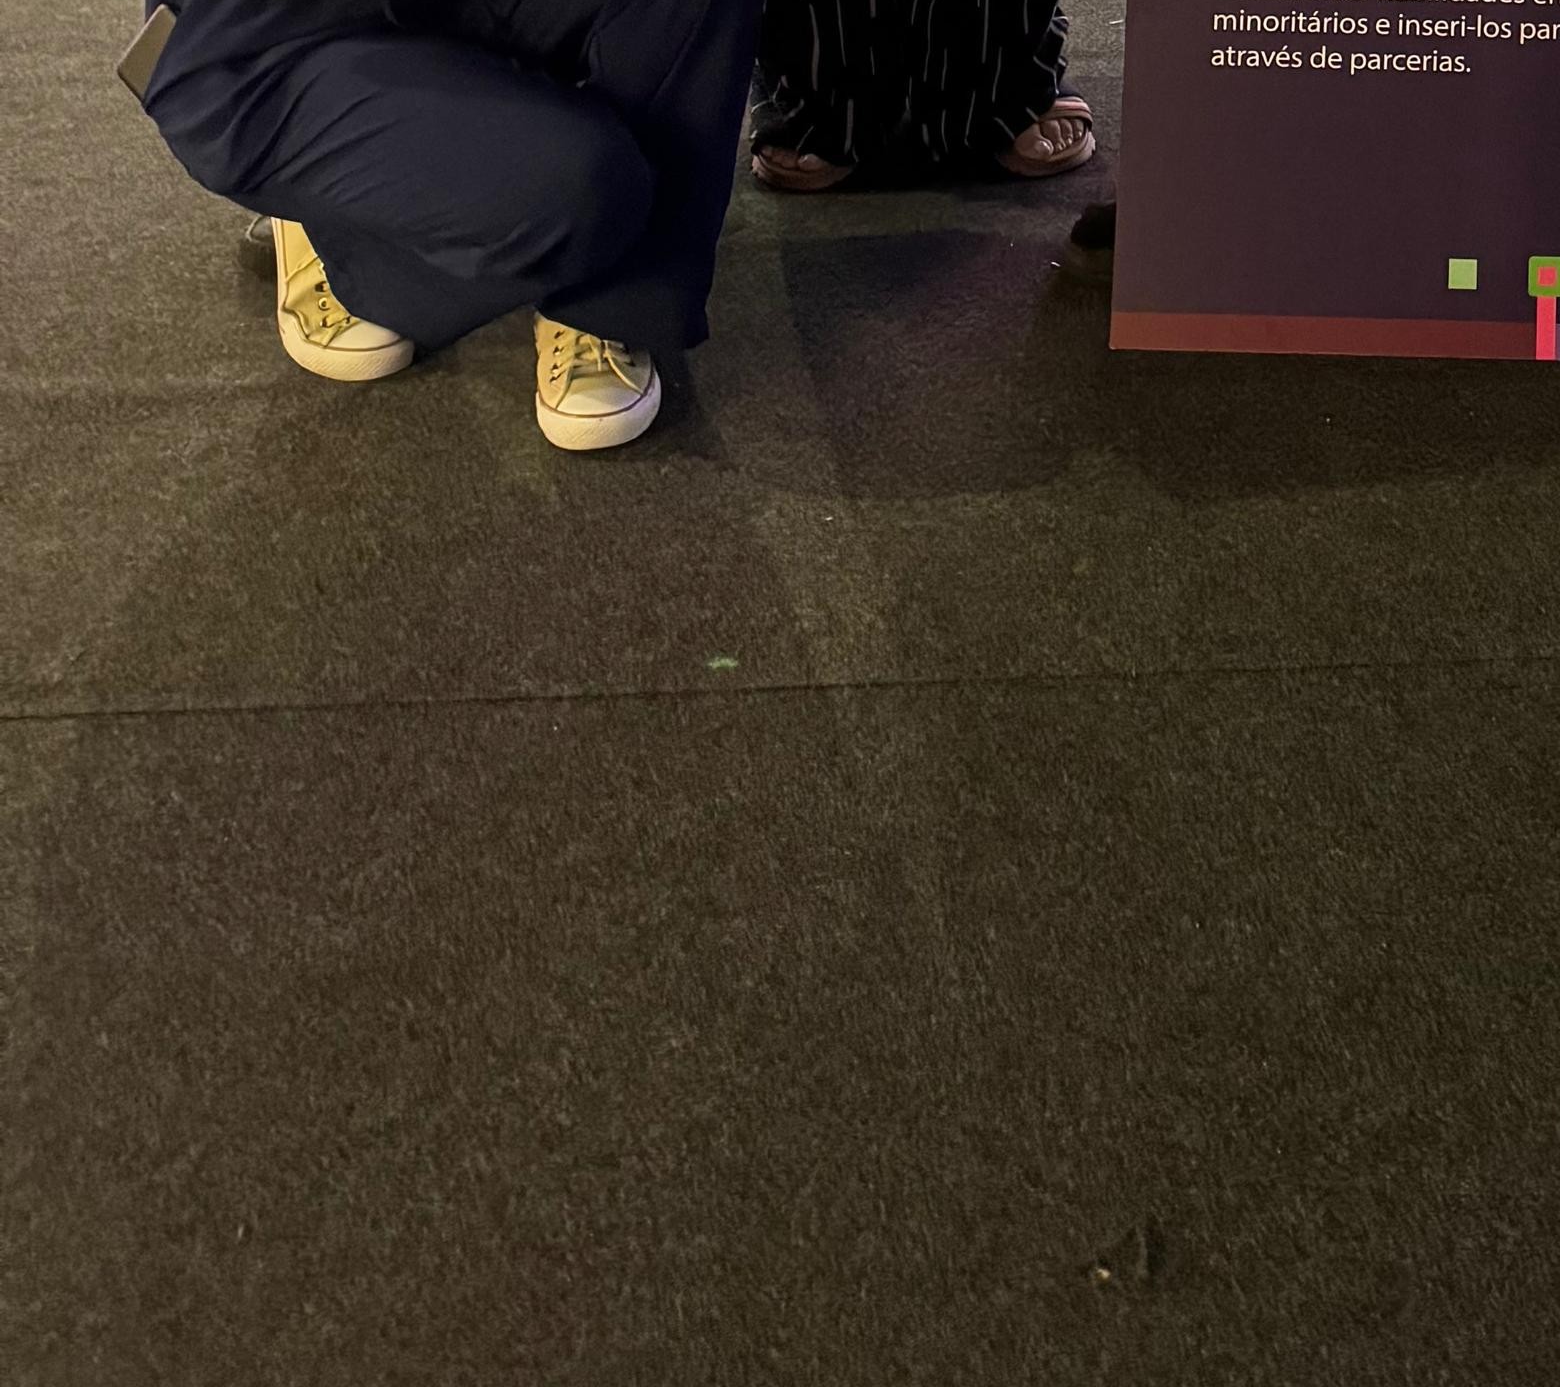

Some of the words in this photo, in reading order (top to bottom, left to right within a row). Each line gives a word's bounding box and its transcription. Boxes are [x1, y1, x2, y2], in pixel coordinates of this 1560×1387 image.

[1213, 9, 1368, 35] minoritários
[1375, 18, 1391, 35] e
[1398, 13, 1512, 39] inseri-los
[1211, 44, 1303, 68] através
[1309, 45, 1343, 69] de
[1350, 49, 1471, 76] parcerias.
